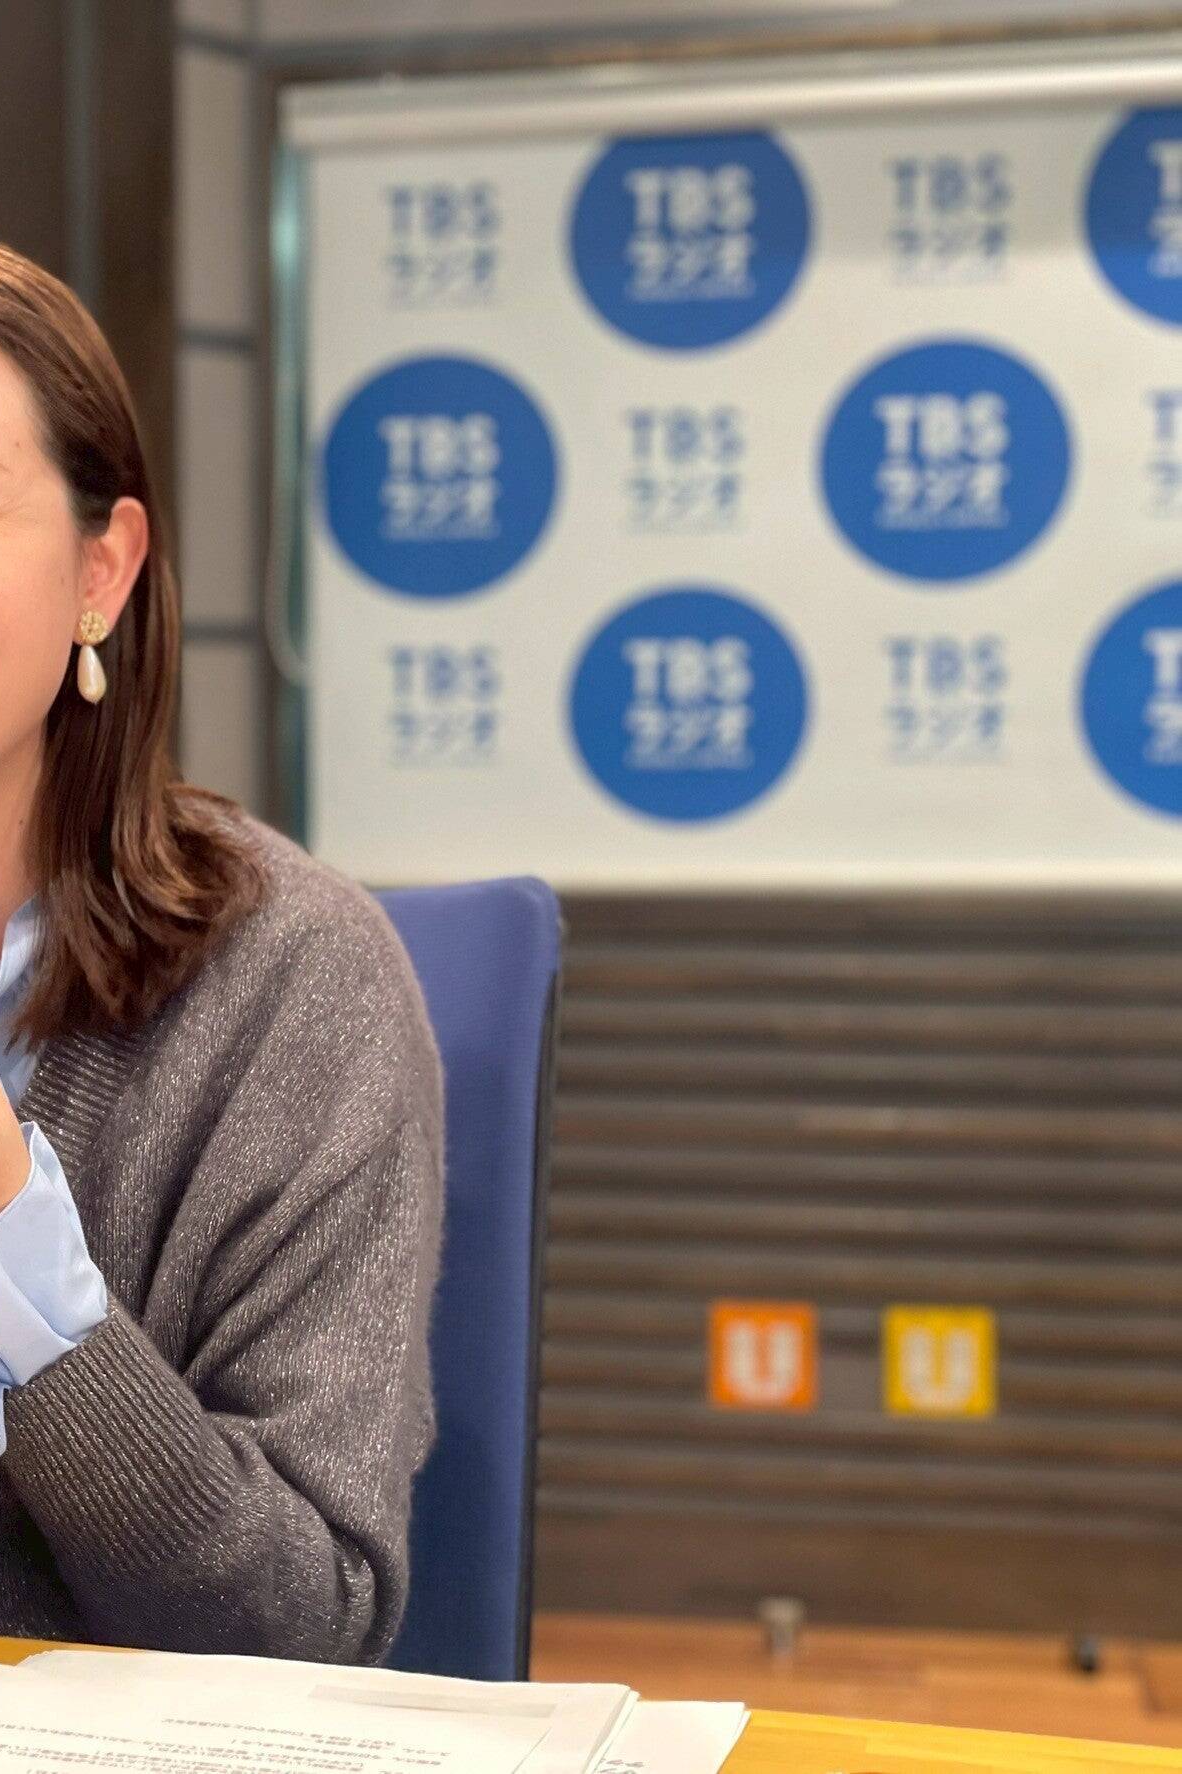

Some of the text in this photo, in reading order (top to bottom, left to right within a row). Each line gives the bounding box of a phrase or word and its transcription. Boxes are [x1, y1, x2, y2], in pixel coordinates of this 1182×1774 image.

[386, 184, 500, 239] TBS
[625, 167, 755, 229] TBS
[889, 155, 1013, 212] TBS
[379, 415, 499, 476] TBS
[627, 407, 744, 462] TBS
[874, 393, 1009, 461] TBS
[390, 647, 501, 699] TBS
[623, 637, 753, 704] TBS
[884, 635, 1009, 696] TBS
